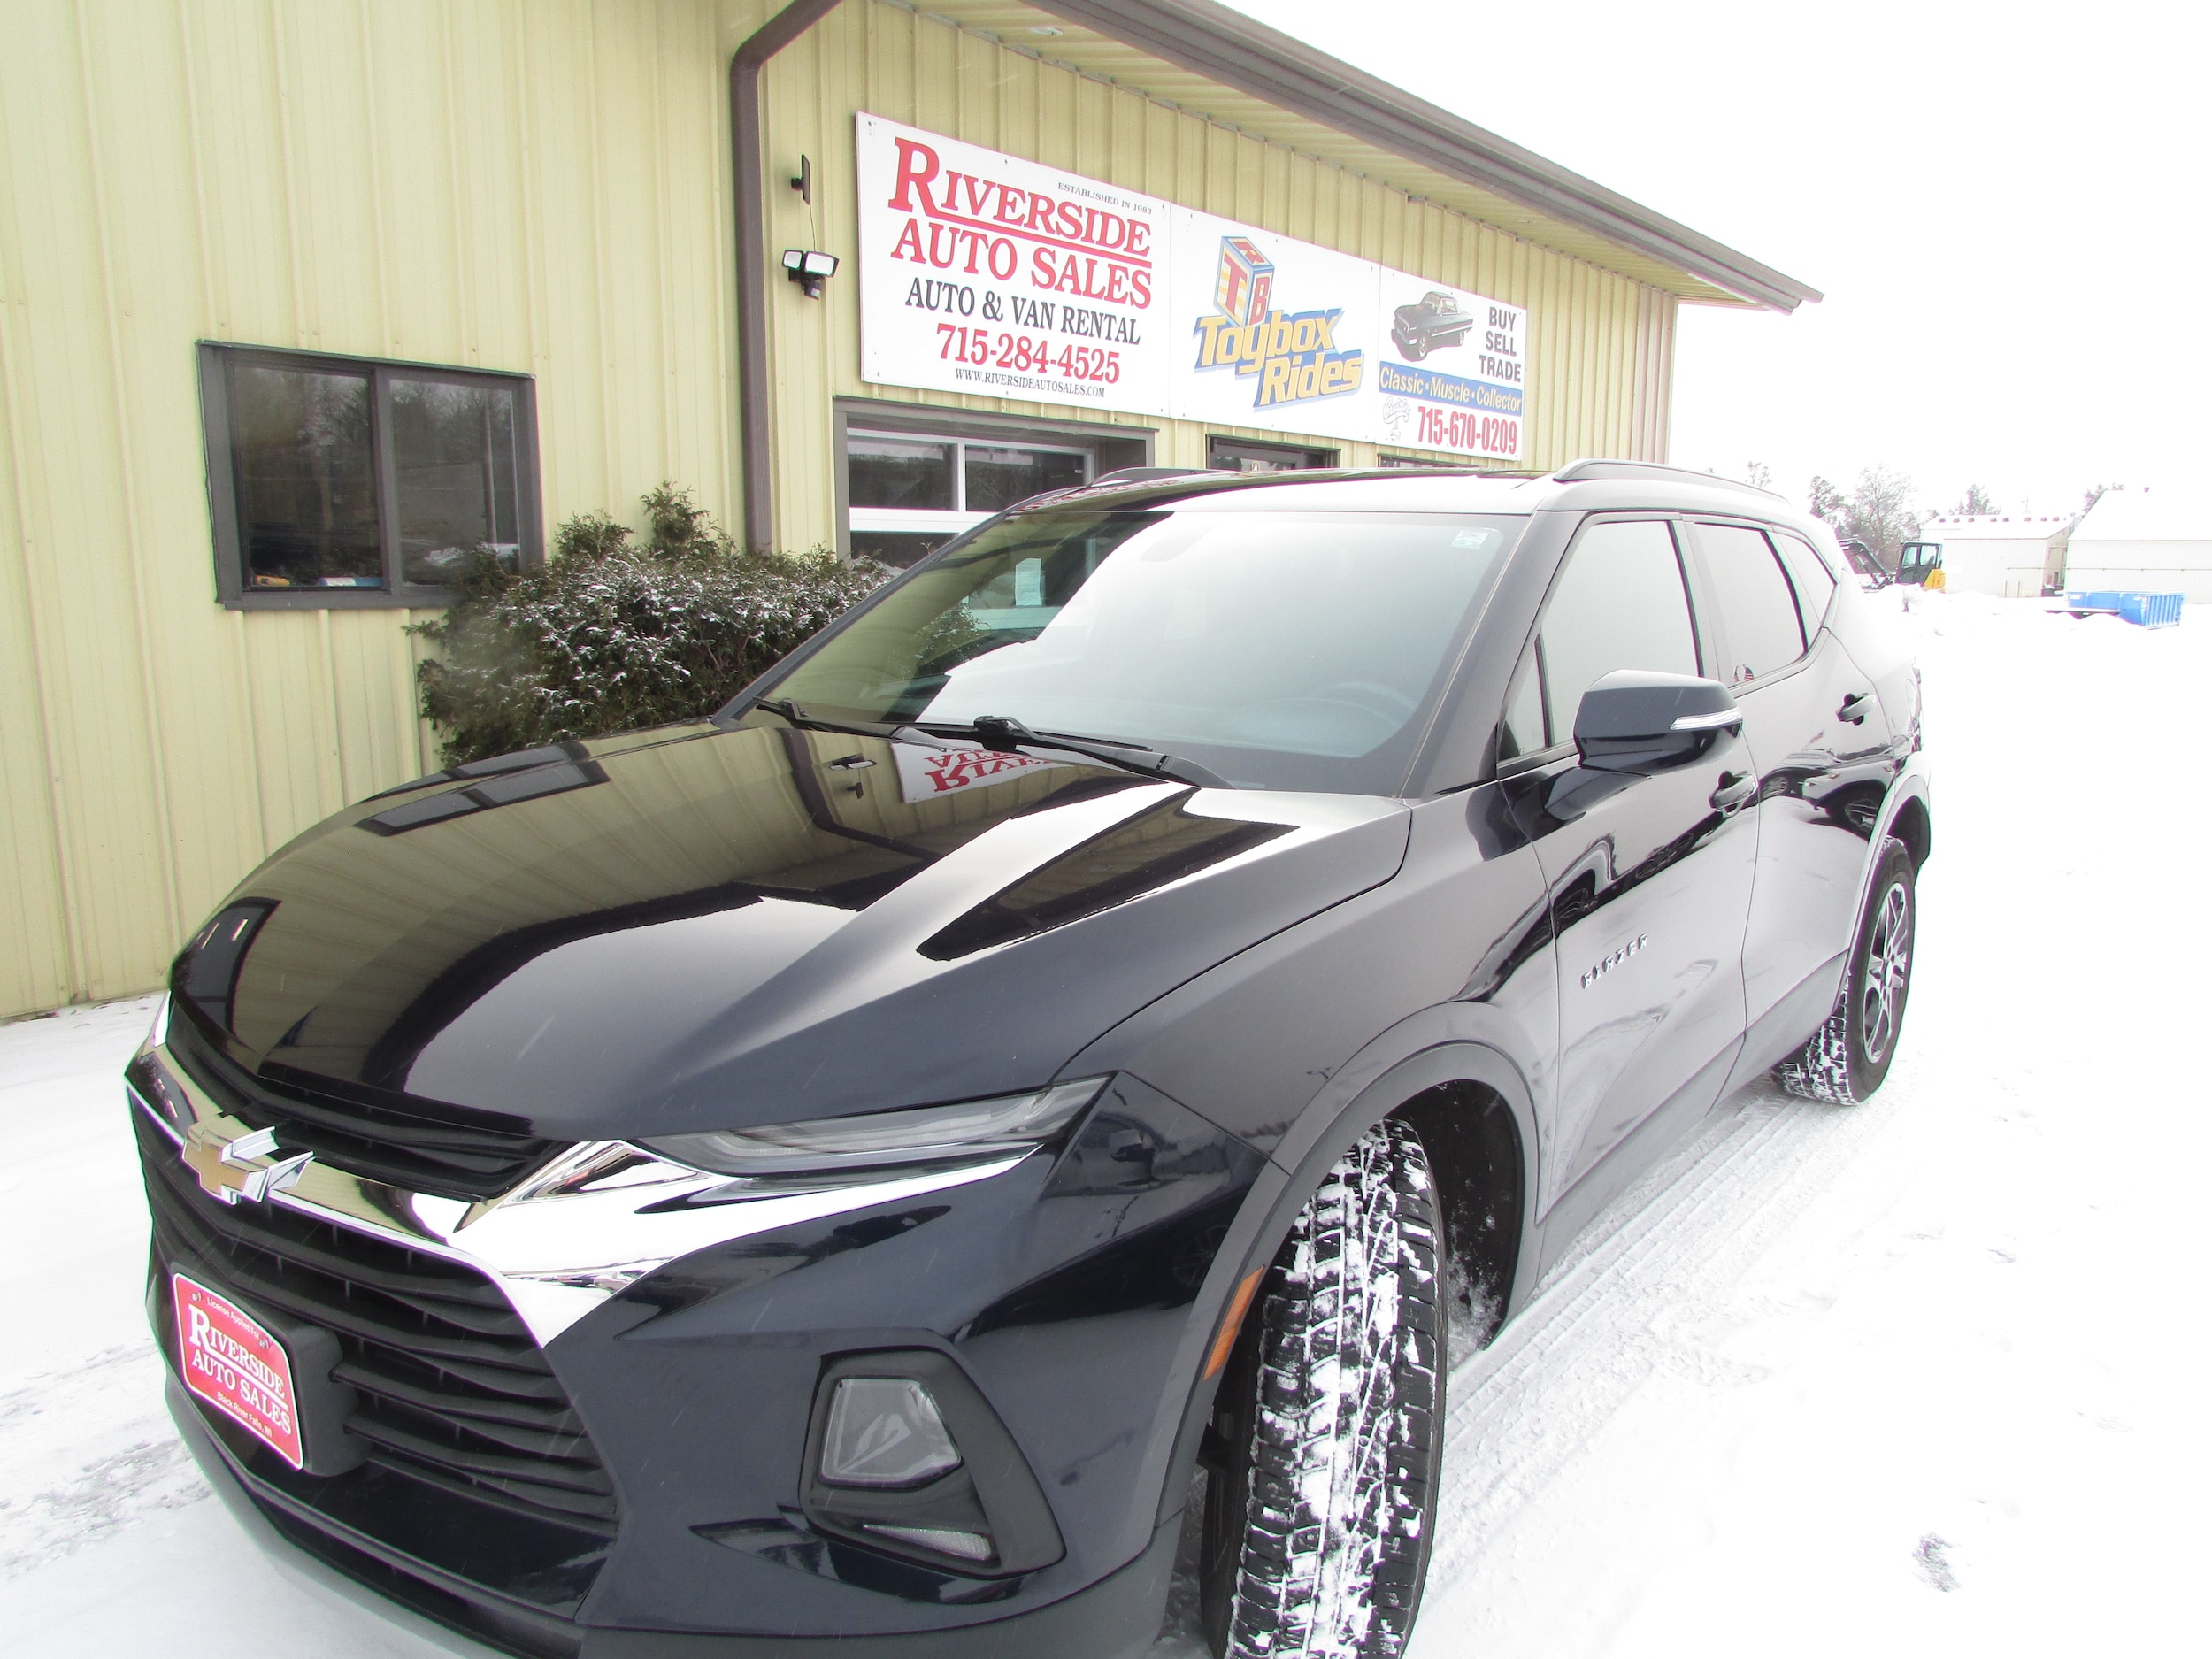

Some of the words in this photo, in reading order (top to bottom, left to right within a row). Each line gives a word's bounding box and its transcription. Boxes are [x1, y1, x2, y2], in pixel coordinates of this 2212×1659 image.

[888, 136, 1151, 257] RIVERSIDE
[1057, 182, 1119, 206] ESTABLISHED
[1121, 200, 1131, 210] IN
[1133, 204, 1152, 215] 1983
[890, 217, 1018, 281] AUTO
[1031, 247, 1152, 310] SALES
[905, 277, 974, 317] AUTO
[982, 291, 1004, 322] &
[1011, 296, 1056, 330] VAN
[1061, 305, 1141, 345] RENTAL
[1488, 305, 1517, 332] BUY
[936, 323, 1120, 384] 715-284-4525
[1197, 311, 1340, 376] Toybox
[1479, 354, 1522, 383] TRADE
[1486, 330, 1517, 357] SELL
[955, 368, 1105, 398] WWW.RIVERSIDEAUTOSALES.COM
[1259, 352, 1363, 407] Rides
[1380, 366, 1424, 396] Classic
[1430, 376, 1470, 403] Muscle
[1476, 386, 1522, 412] Collector
[1418, 406, 1517, 455] 715-670-0209
[1580, 933, 1648, 989] BLAZER
[206, 1296, 230, 1317] License
[230, 1311, 250, 1333] Applied
[188, 1303, 286, 1400] RIVERSIDE
[191, 1349, 236, 1391] AUTO
[240, 1379, 292, 1435] SALES
[217, 1390, 234, 1409] Black
[233, 1402, 249, 1419] River
